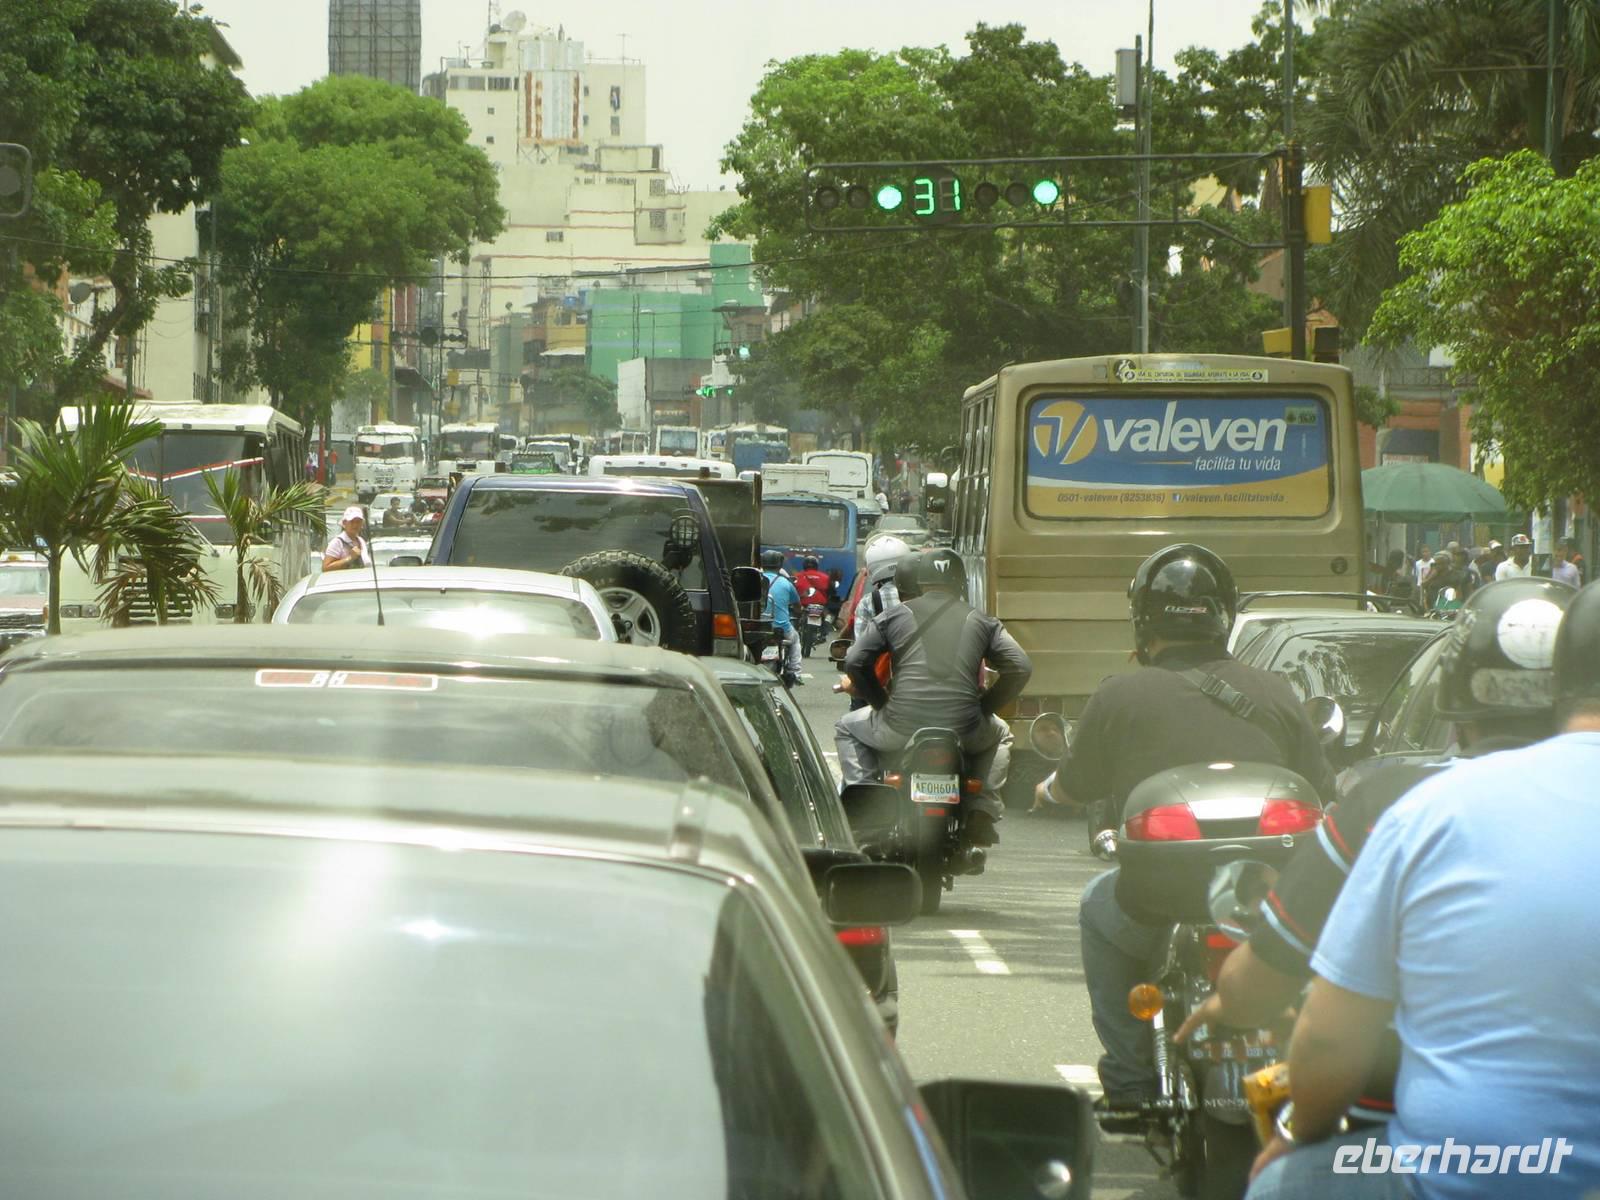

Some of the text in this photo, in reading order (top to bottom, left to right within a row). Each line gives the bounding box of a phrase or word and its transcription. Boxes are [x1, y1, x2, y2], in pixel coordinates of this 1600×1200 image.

[914, 178, 961, 215] 31
[1103, 400, 1287, 453] valeven
[1194, 456, 1281, 471] facilita tu vida
